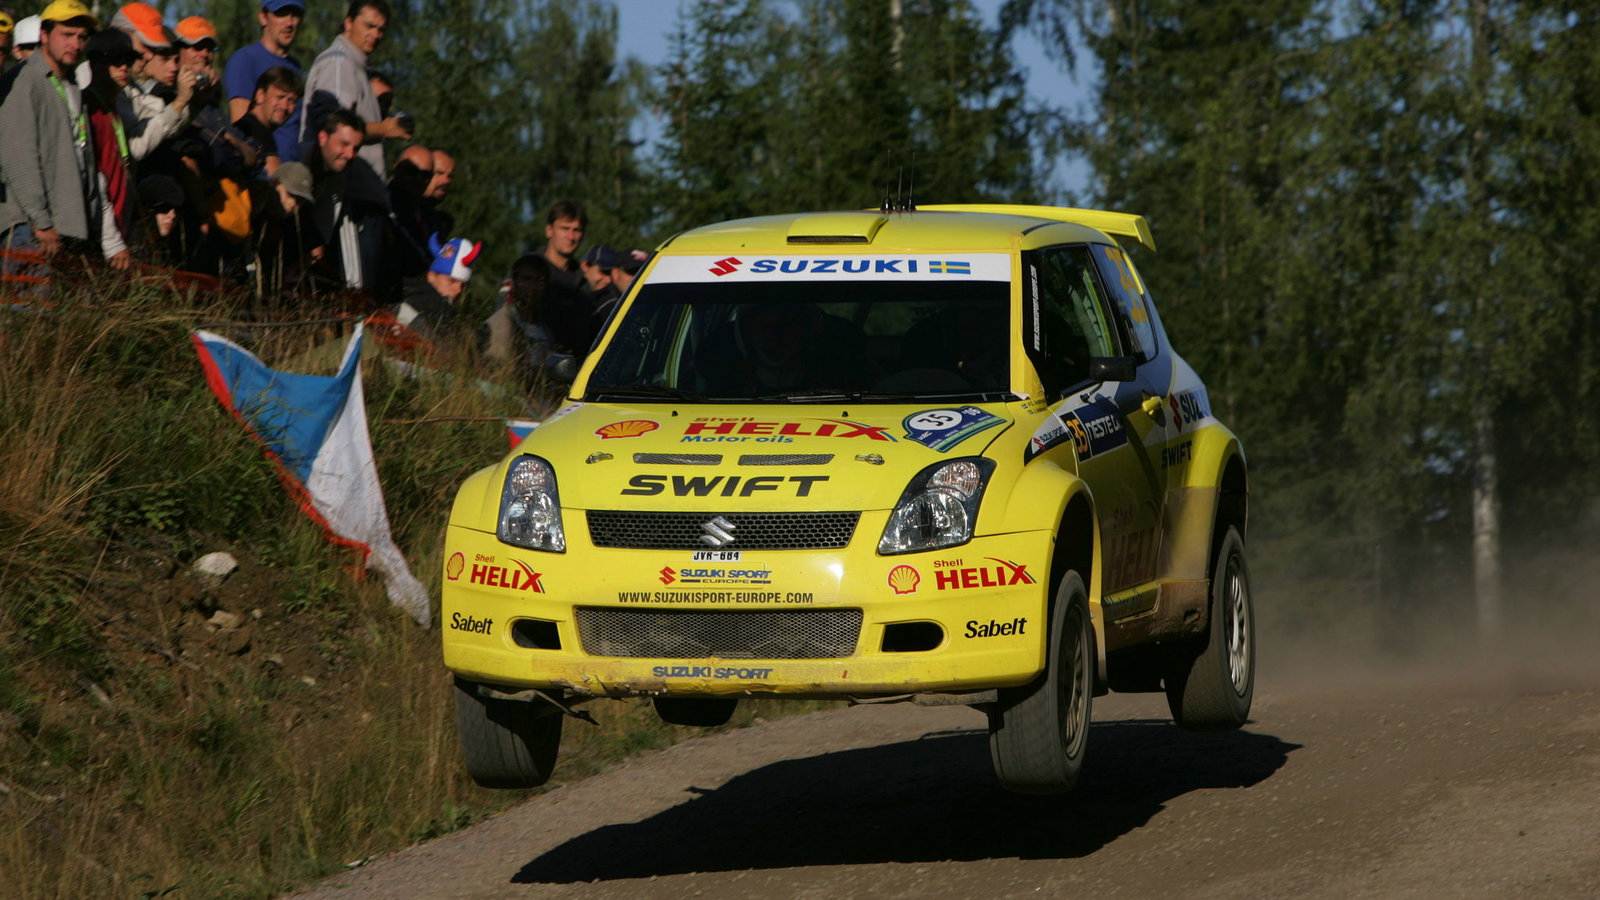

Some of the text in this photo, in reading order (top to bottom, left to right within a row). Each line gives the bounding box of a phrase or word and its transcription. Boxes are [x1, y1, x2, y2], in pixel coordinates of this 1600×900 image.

[749, 259, 918, 274] SUZUKI
[917, 414, 954, 427] 35
[680, 435, 794, 443] Motor oils
[683, 421, 891, 442] HELIX
[1066, 418, 1088, 454] 35
[1161, 439, 1192, 470] SWIFT
[620, 474, 831, 498] SWIFT
[475, 553, 496, 563] Shell
[933, 558, 963, 568] Shell
[470, 564, 544, 594] HELIX
[680, 568, 772, 579] SUZUKI SPORT
[934, 564, 1034, 590] HELIX
[618, 592, 814, 604] WWW.SUZUKISPORT-EUROPE.COM
[450, 612, 493, 636] Sabelt
[964, 617, 1028, 639] Sabelt
[652, 666, 774, 680] SUZUKI SPORT
